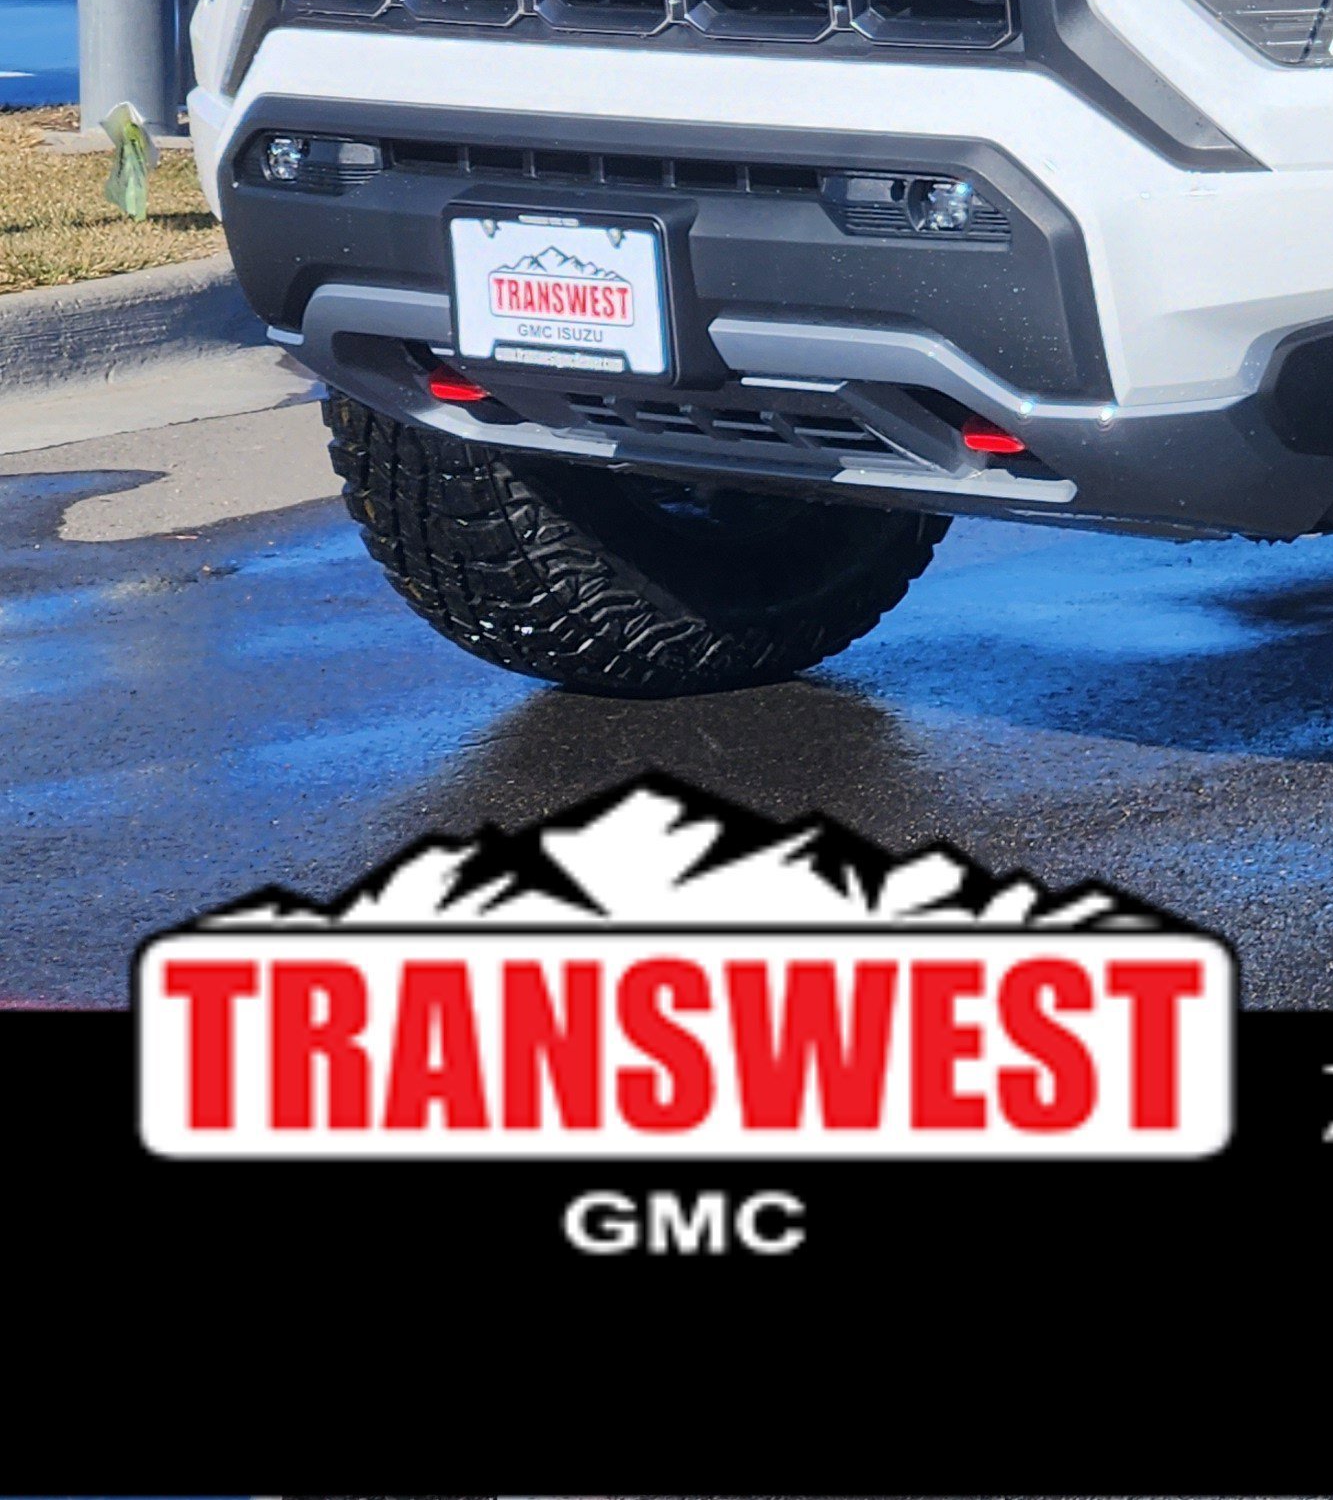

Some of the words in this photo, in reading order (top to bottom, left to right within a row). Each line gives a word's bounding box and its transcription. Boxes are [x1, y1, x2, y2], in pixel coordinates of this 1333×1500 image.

[492, 278, 629, 320] TRANSWEST
[517, 323, 552, 339] GMC
[557, 324, 604, 343] ISUZU
